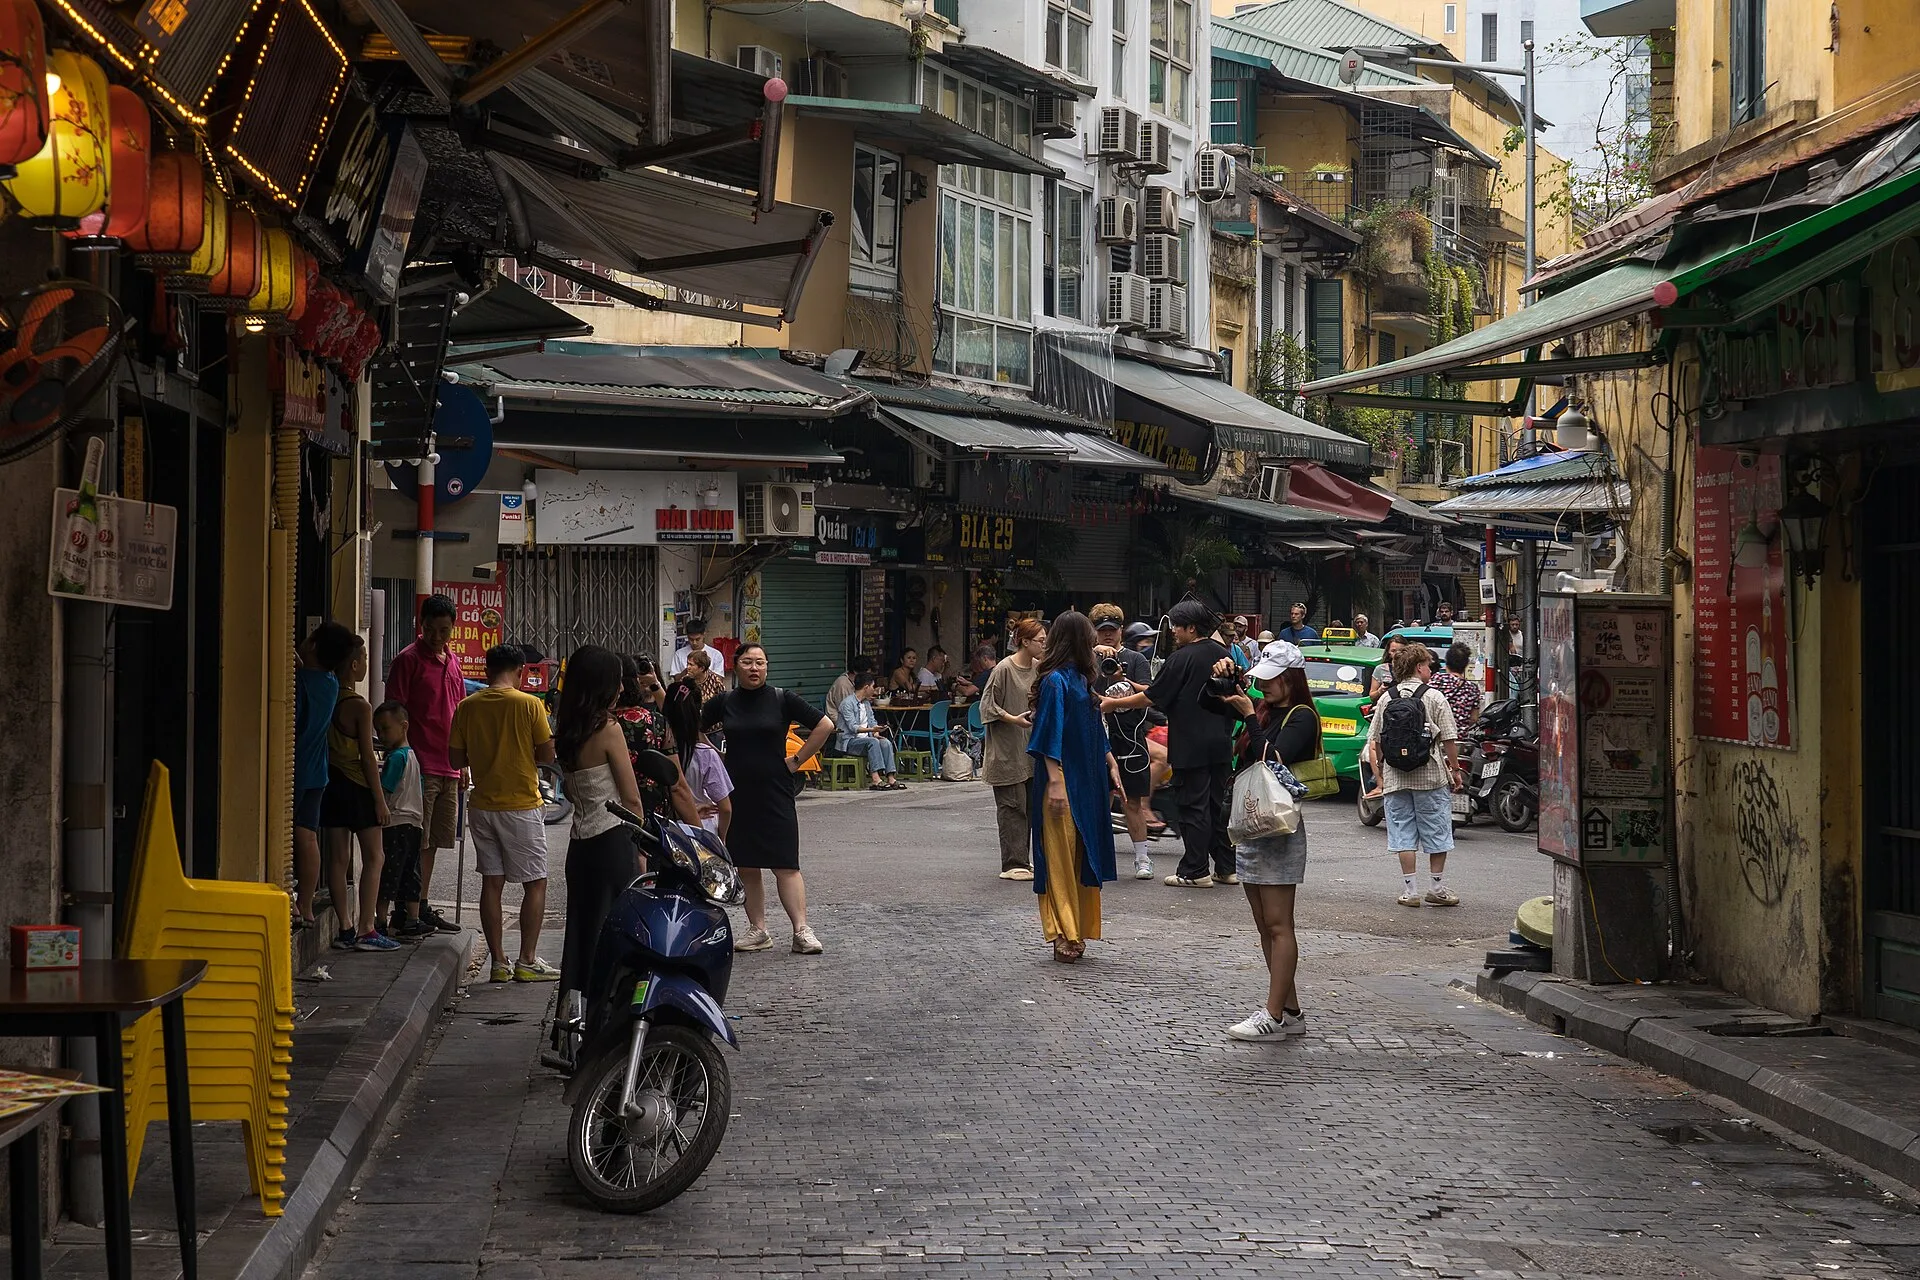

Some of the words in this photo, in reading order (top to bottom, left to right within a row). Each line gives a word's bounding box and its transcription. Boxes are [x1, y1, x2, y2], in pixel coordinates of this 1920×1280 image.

[818, 515, 848, 545] Quán
[960, 514, 990, 549] BIA
[994, 517, 1014, 550] 29
[462, 587, 479, 606] CÁ
[464, 627, 479, 640] ĐA
[664, 894, 691, 904] HONDA
